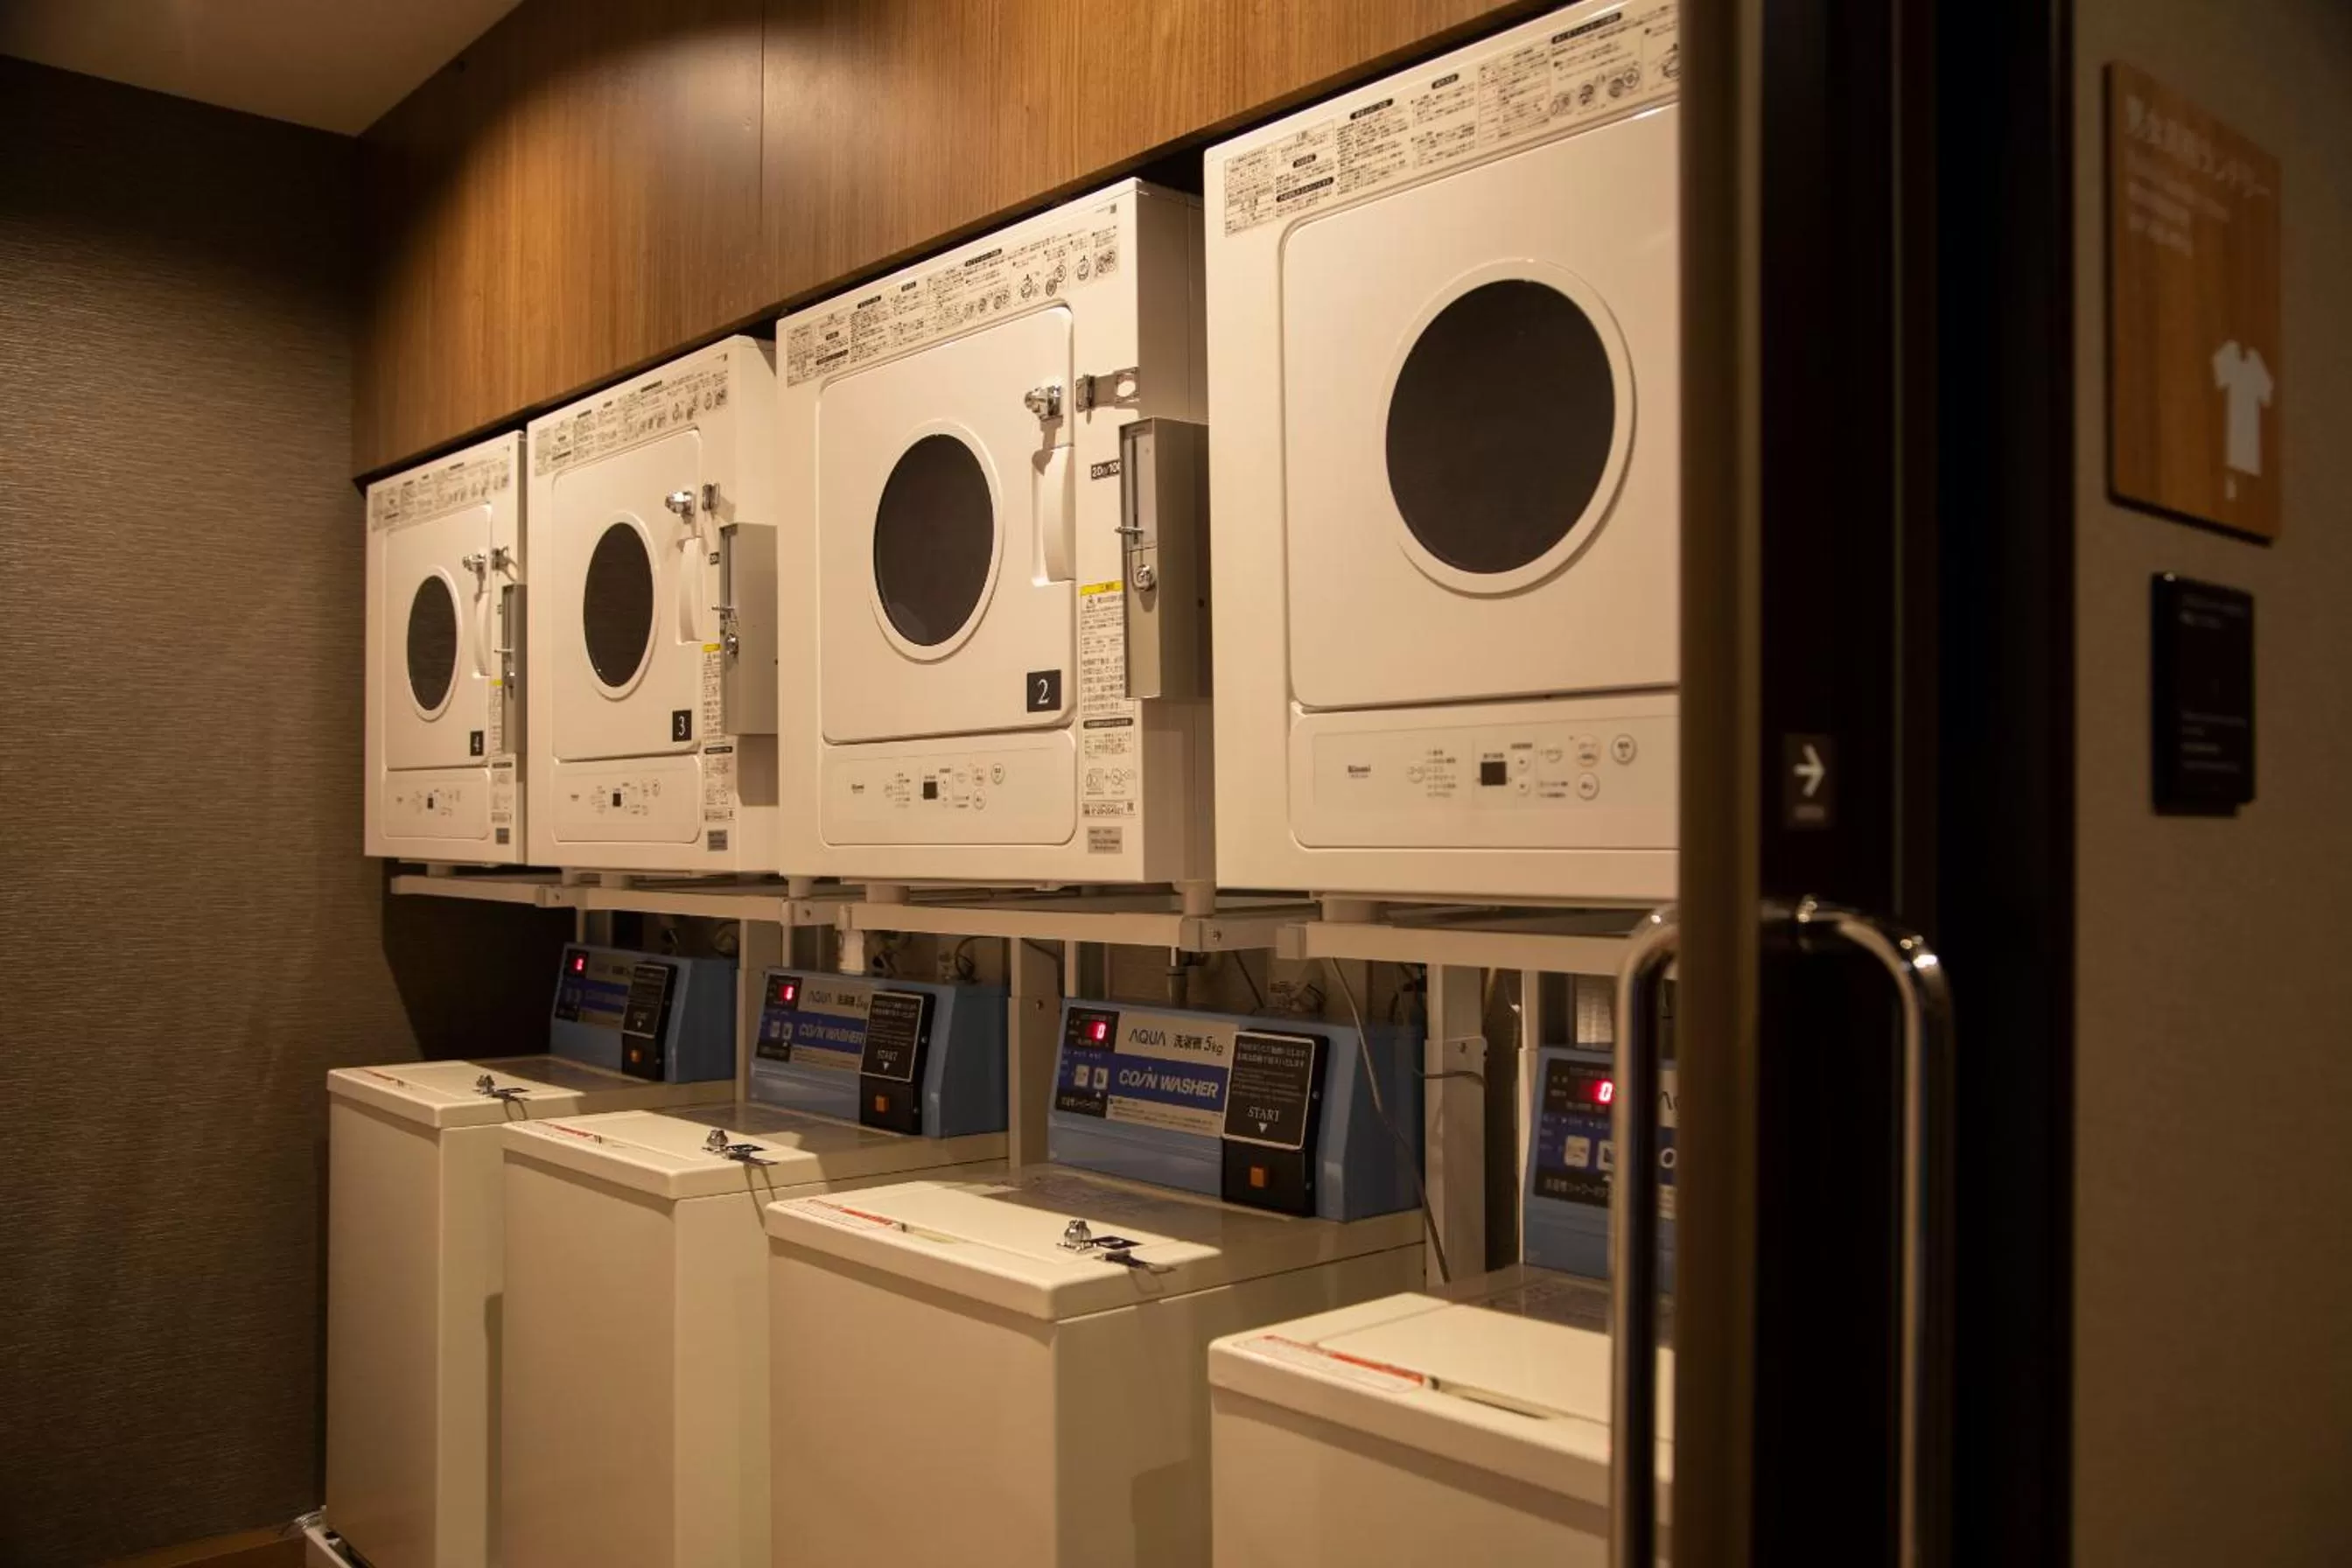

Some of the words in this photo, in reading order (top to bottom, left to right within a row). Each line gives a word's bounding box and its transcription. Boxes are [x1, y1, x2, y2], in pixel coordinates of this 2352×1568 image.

[1036, 678, 1050, 704] 2
[678, 715, 686, 736] 3
[1096, 1022, 1106, 1040] 0
[1128, 1028, 1166, 1046] AQUA
[1119, 1066, 1158, 1089] COIN
[1159, 1074, 1219, 1099] WASHER
[1598, 1081, 1614, 1102] 0
[1248, 1106, 1279, 1122] START
